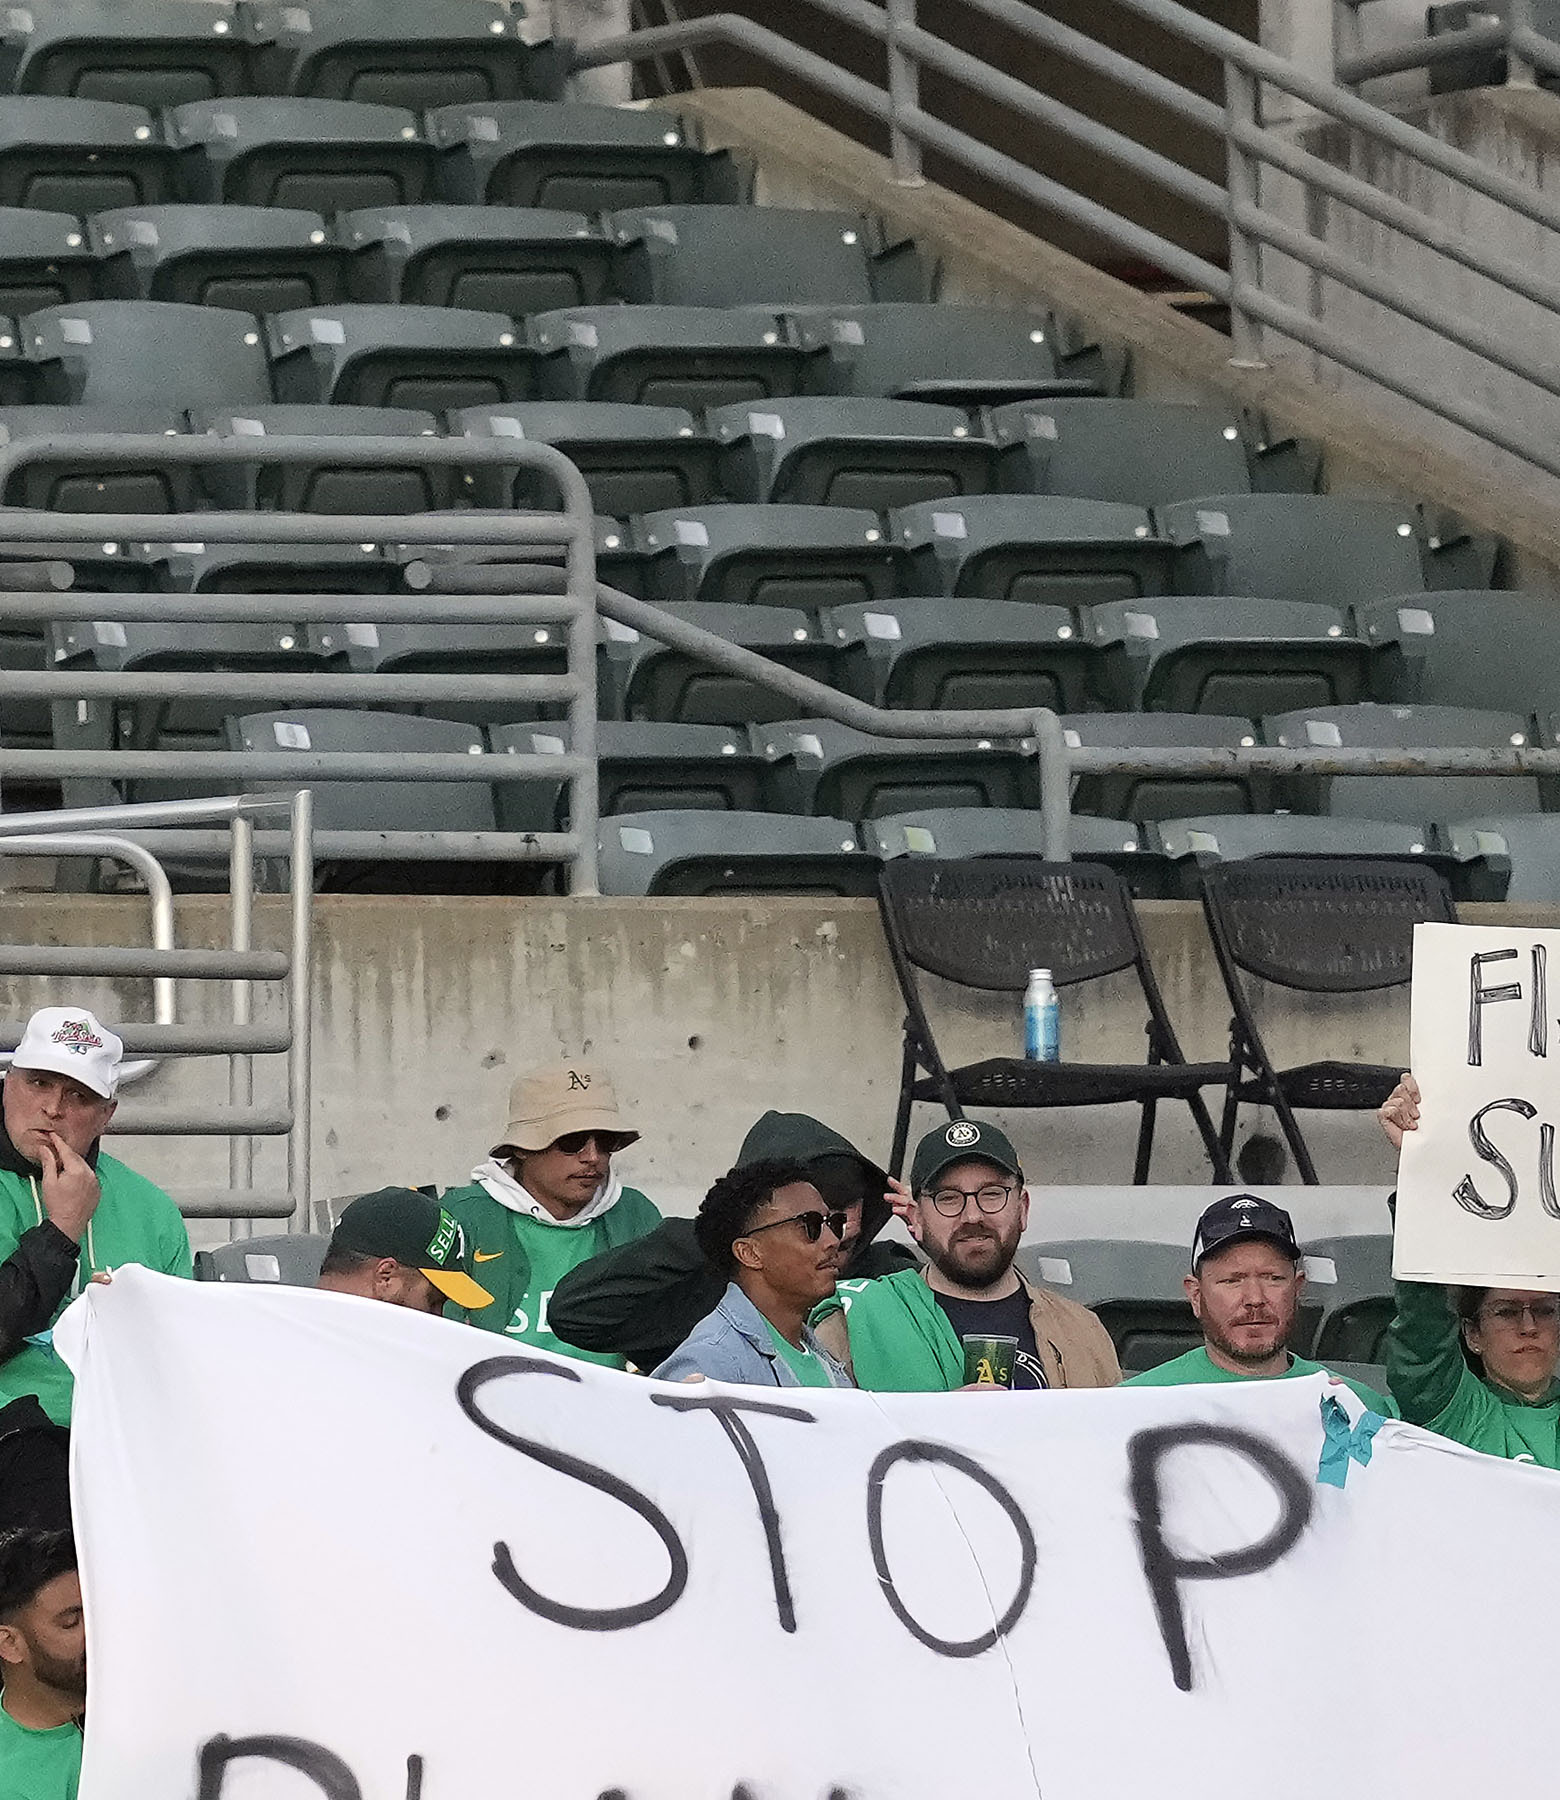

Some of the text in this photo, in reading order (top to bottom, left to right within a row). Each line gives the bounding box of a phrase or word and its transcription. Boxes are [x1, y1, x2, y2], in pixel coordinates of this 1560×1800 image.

[1467, 943, 1560, 1067] FI
[566, 1069, 591, 1092] A's
[430, 1217, 456, 1260] SELL
[503, 1290, 556, 1335] SE
[976, 1358, 1008, 1386] A's
[455, 1355, 1314, 1692] STOP
